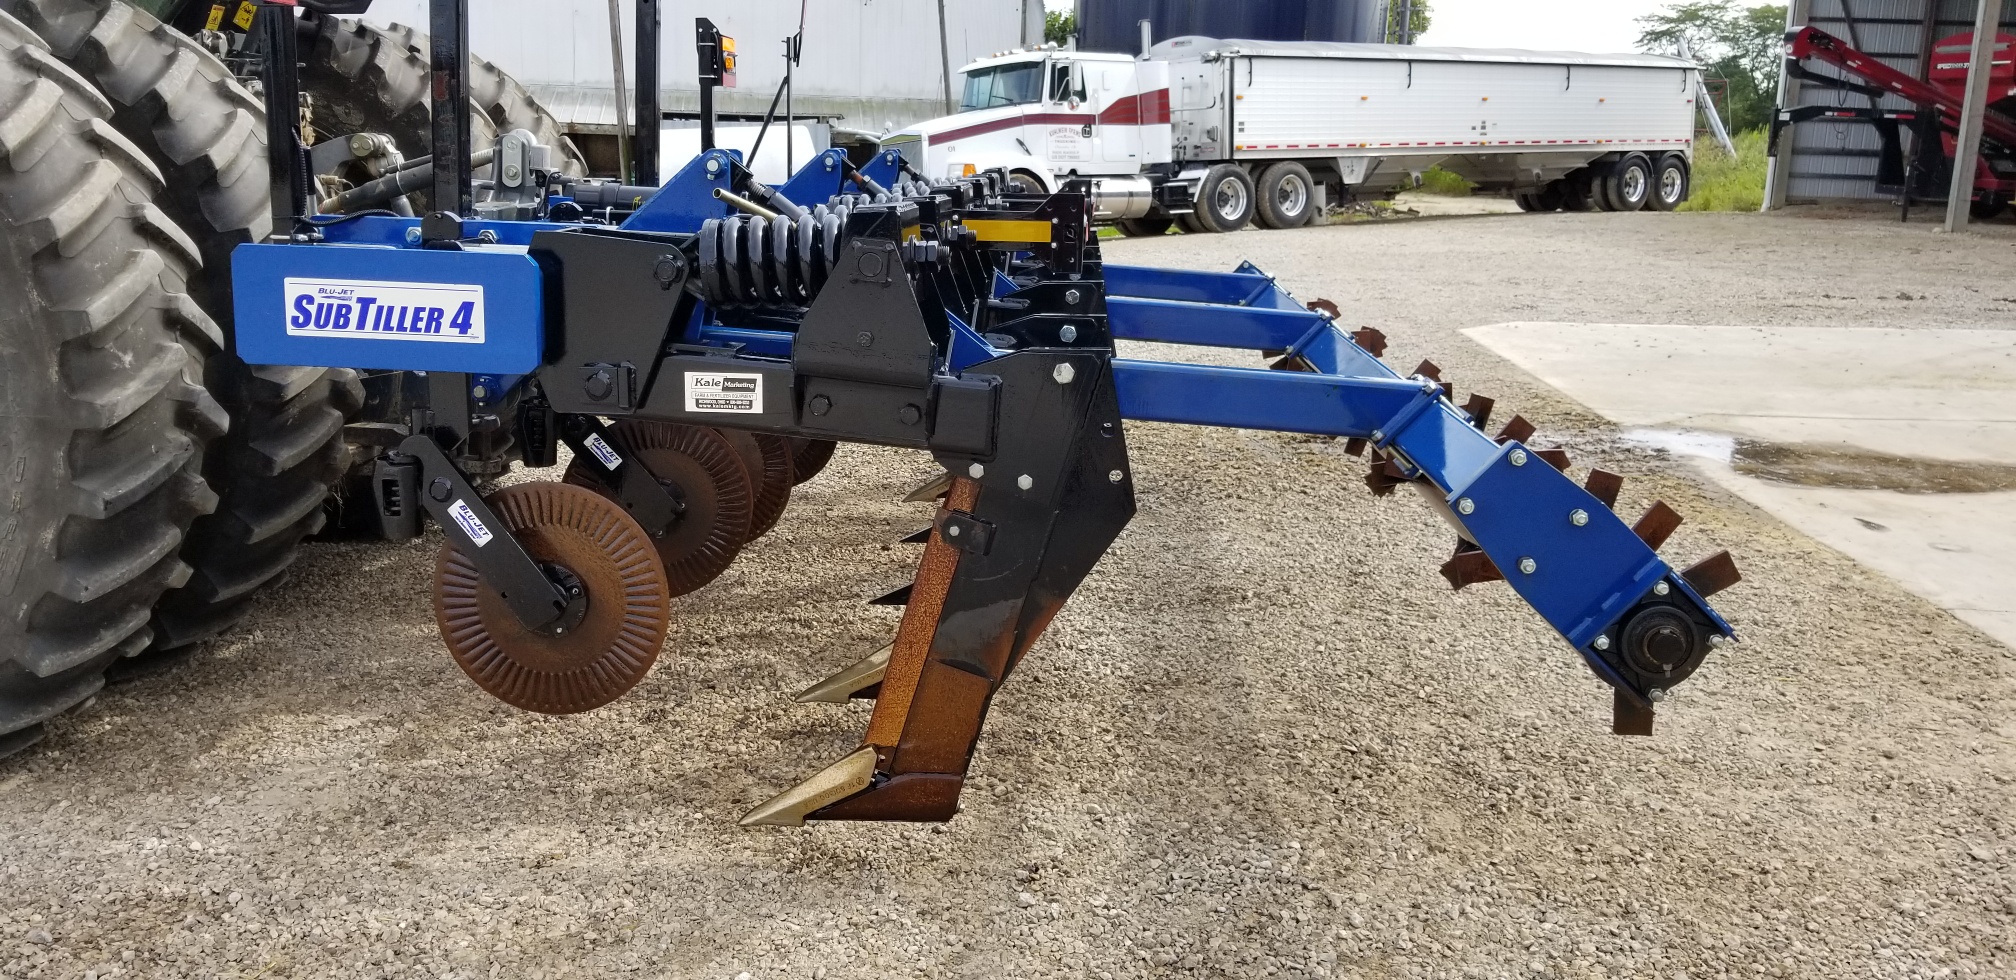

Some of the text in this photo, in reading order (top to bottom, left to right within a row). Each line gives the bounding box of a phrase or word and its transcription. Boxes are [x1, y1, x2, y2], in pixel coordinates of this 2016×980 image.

[318, 288, 354, 296] BLU-JET
[449, 301, 475, 335] 4
[694, 378, 721, 386] Kale
[459, 505, 489, 536] BLU-JET
